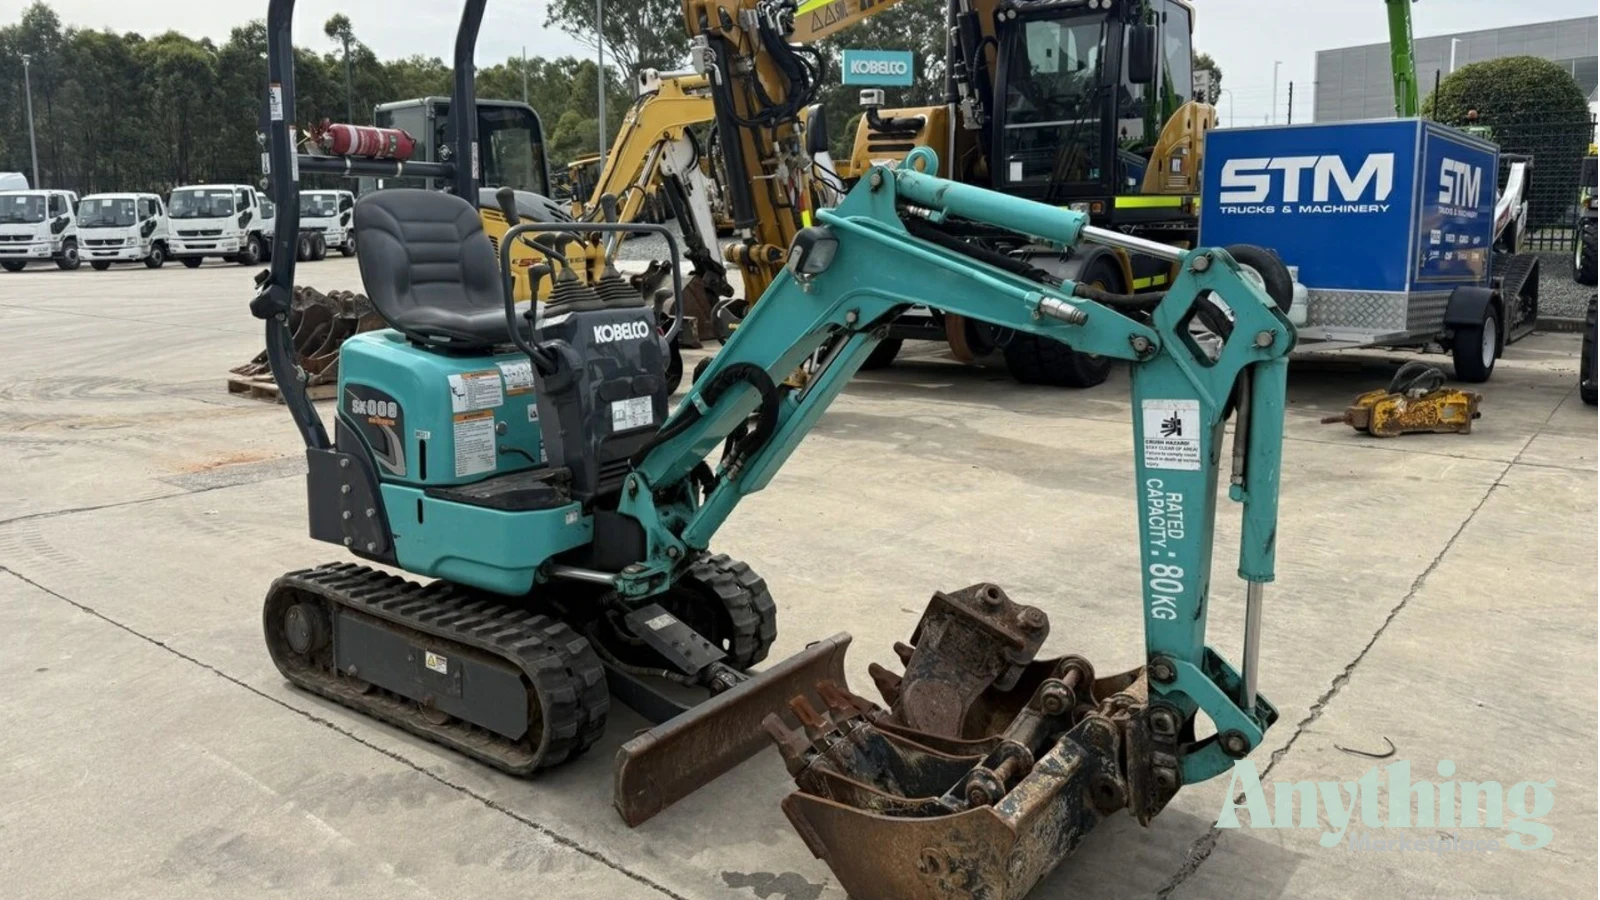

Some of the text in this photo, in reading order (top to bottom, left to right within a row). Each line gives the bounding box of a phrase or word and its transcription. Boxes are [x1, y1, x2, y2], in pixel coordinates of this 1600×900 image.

[851, 60, 908, 75] KOBELCO
[1219, 153, 1395, 204] STM
[1438, 157, 1482, 209] STM
[1220, 204, 1391, 214] TRUCKS & MACHINERY
[593, 321, 650, 344] KOBELCO
[1166, 492, 1184, 539] RATED
